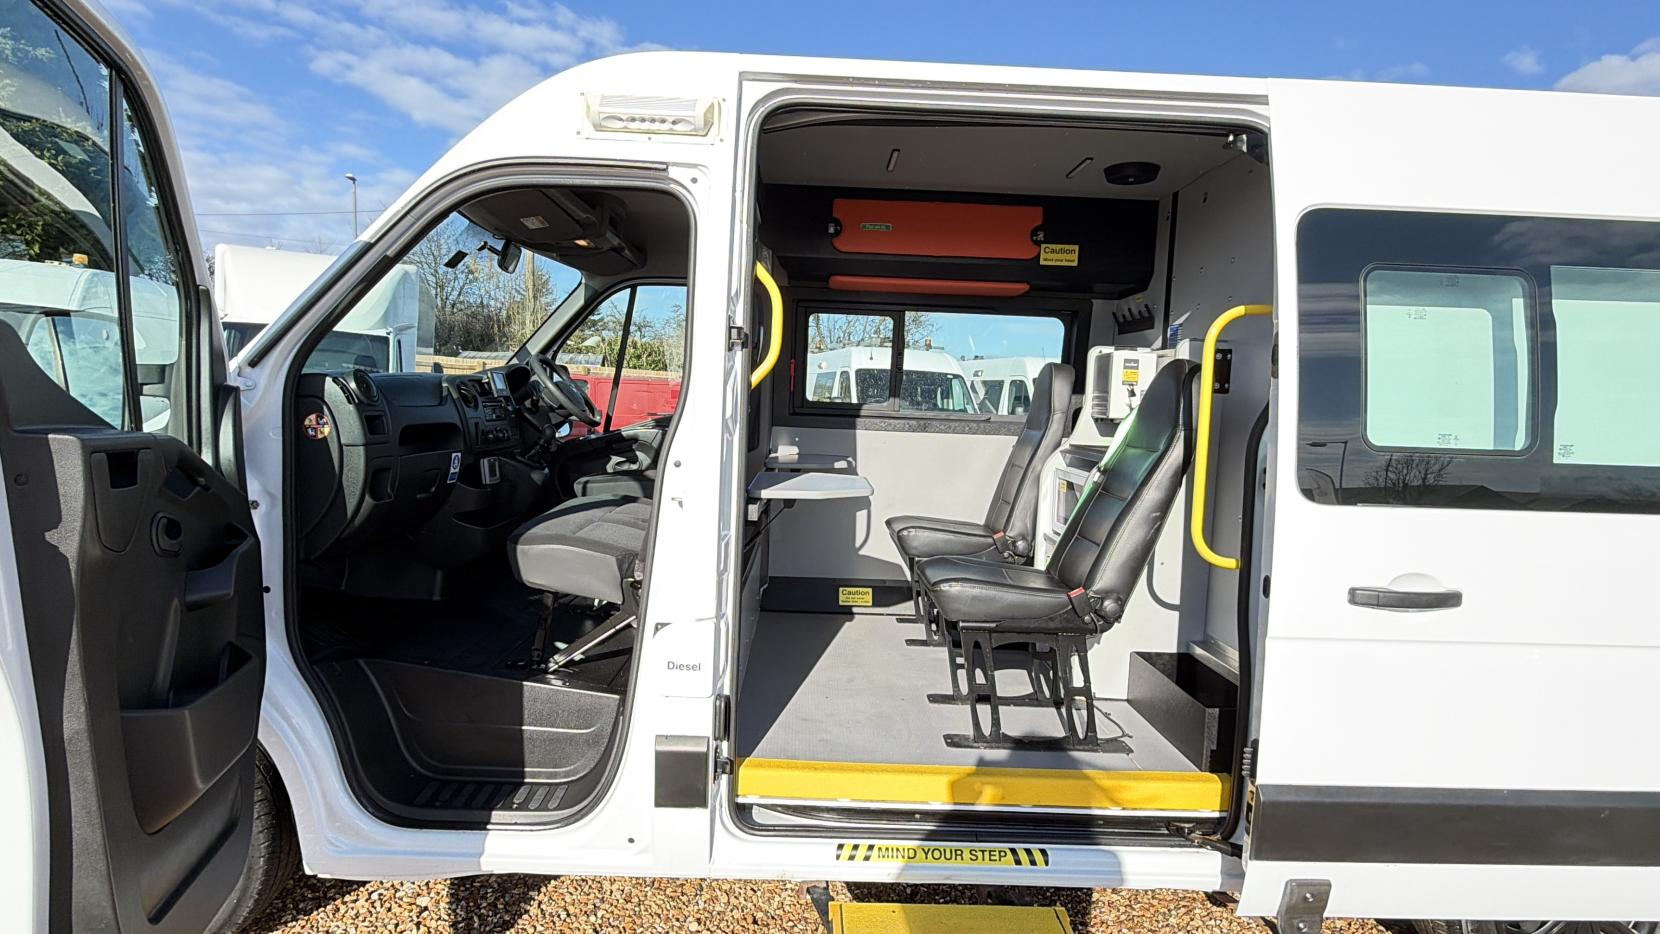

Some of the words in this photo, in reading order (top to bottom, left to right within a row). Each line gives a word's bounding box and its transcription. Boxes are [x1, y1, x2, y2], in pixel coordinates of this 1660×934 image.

[1043, 246, 1076, 255] Caution
[667, 661, 701, 671] Diesel
[877, 847, 917, 860] MIND
[922, 847, 964, 861] YOUR
[969, 848, 1008, 863] STEP
